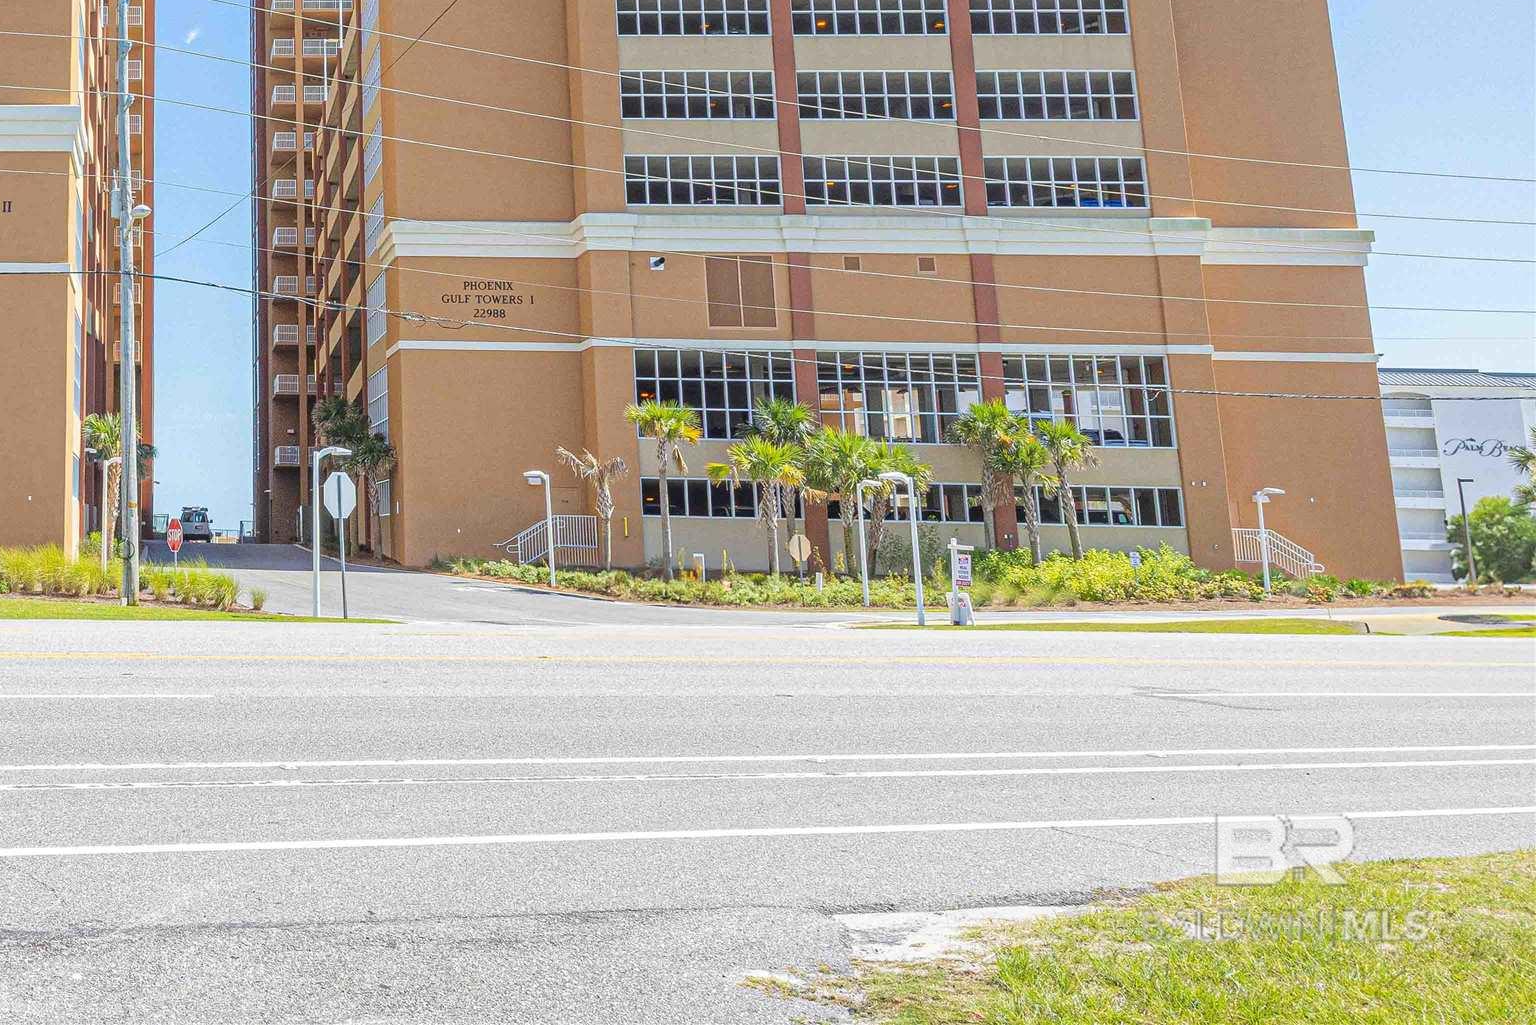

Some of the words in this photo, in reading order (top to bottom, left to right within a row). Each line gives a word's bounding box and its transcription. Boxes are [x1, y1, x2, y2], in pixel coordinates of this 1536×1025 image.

[2, 201, 12, 213] II
[463, 281, 514, 291] PHOENIX
[441, 294, 471, 304] GULF
[475, 295, 523, 305] TOWERS
[473, 308, 506, 318] 22988
[168, 529, 181, 542] STOP
